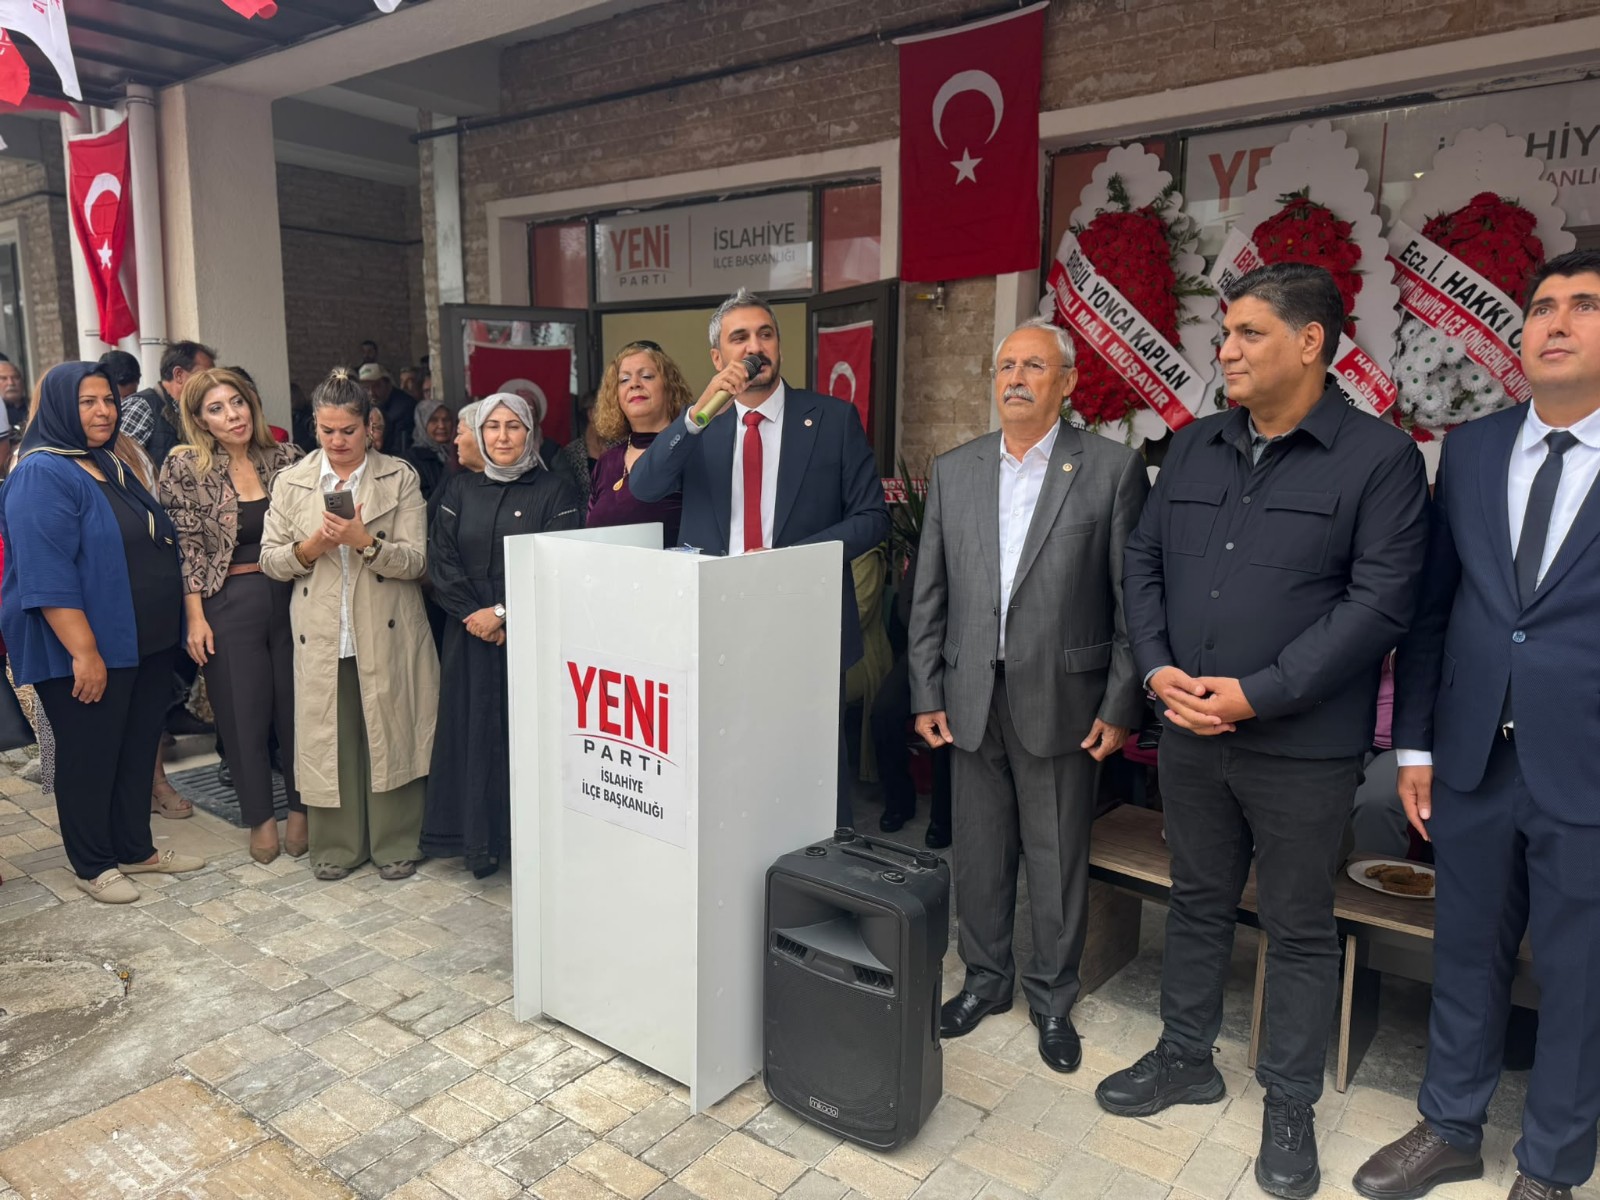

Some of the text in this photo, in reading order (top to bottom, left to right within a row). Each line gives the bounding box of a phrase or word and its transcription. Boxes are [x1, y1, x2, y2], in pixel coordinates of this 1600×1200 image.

[1208, 145, 1275, 213] YE
[713, 220, 795, 251] İSLAHİYE
[1440, 271, 1514, 333] HAKKI
[1088, 281, 1136, 336] YONCA
[1129, 327, 1191, 391] KAPLAN
[1075, 309, 1113, 346] MALİ
[1106, 341, 1170, 409] MÜŞAVİR
[1354, 353, 1395, 396] HAYIRLI
[1344, 369, 1380, 406] OLSUN
[1503, 364, 1532, 402] HAYIR
[582, 778, 664, 820] İLÇE BAŞKANLIĞI
[600, 766, 644, 794] İSLAHİYE
